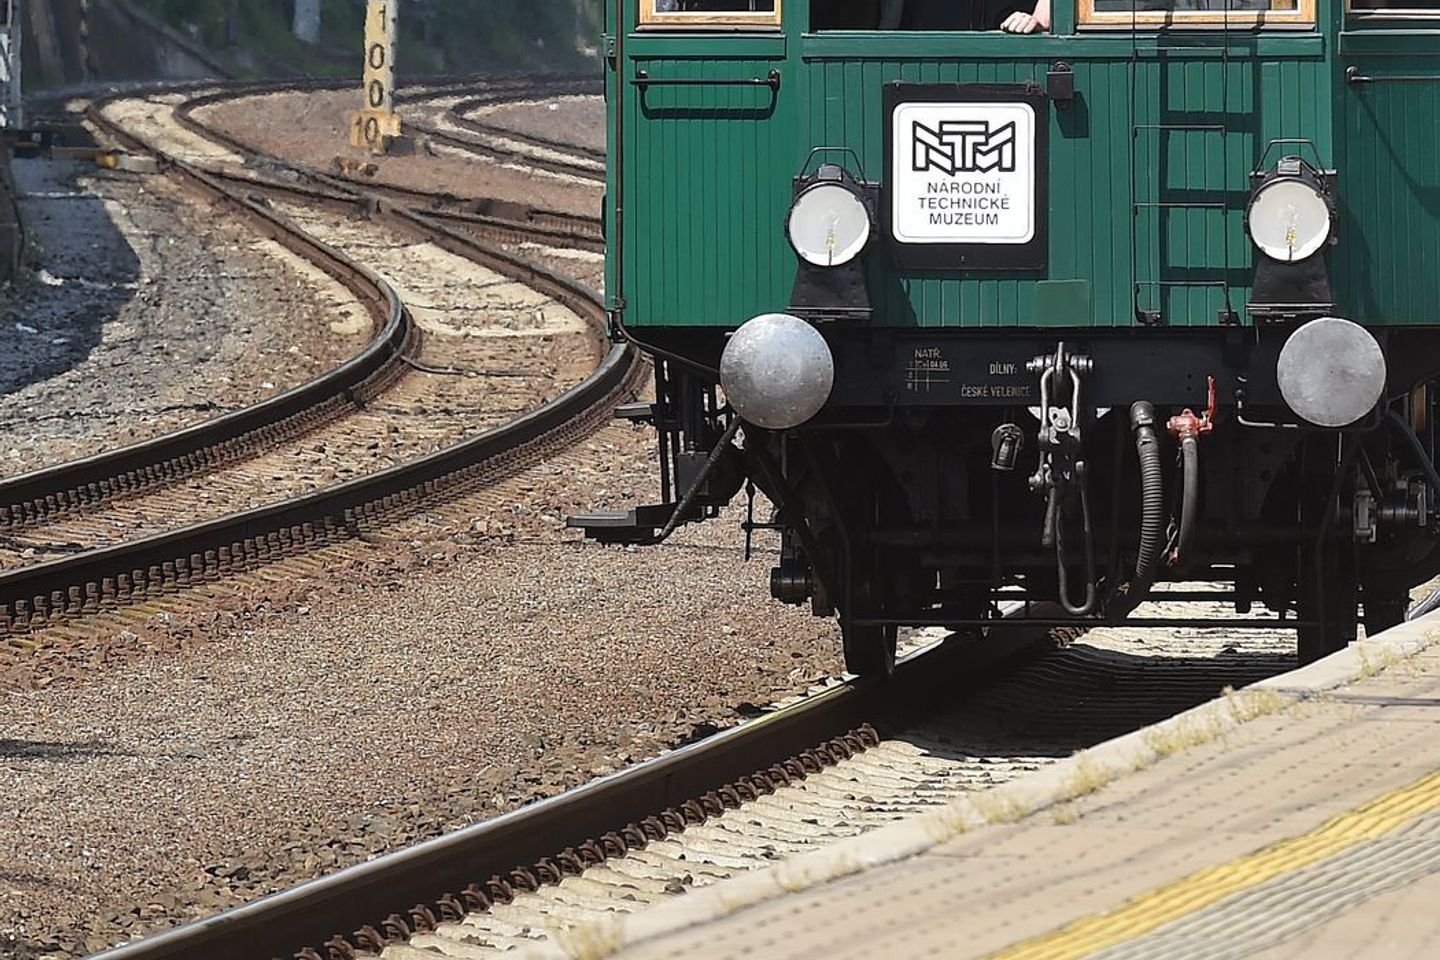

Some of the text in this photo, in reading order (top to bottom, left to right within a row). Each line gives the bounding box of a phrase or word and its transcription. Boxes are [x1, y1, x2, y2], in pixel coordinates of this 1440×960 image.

[927, 178, 1001, 194] NÁRODNÍ
[919, 194, 1010, 210] TECHNICKÉ
[929, 213, 999, 225] MUZEUM
[990, 361, 1018, 375] DÍLNY:
[961, 384, 988, 398] ČESKÉ
